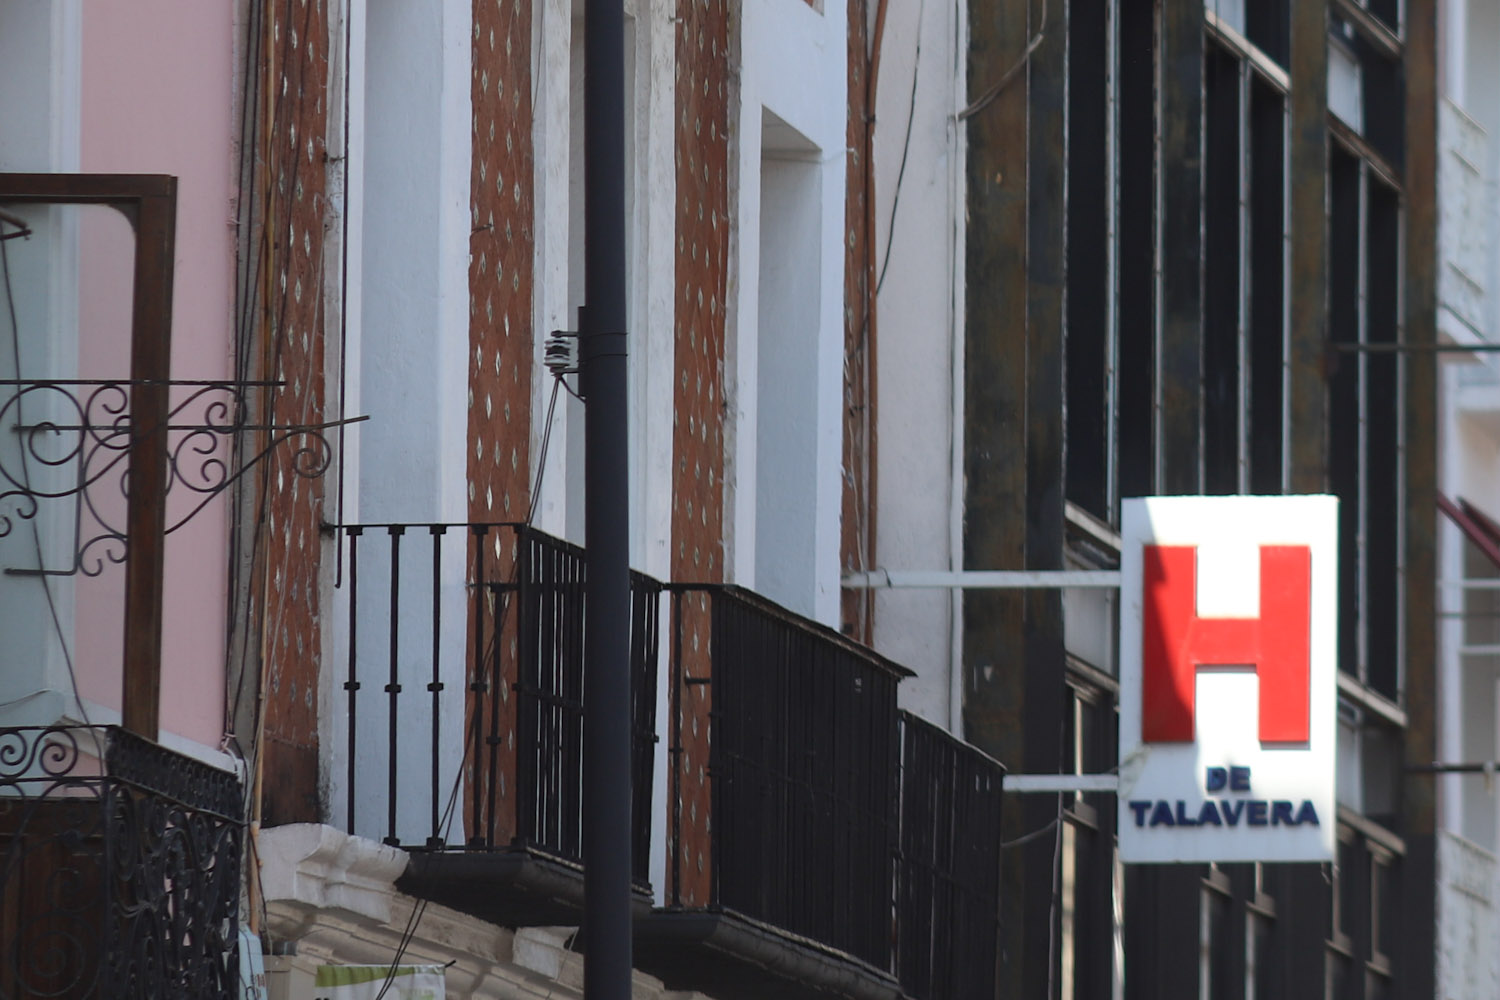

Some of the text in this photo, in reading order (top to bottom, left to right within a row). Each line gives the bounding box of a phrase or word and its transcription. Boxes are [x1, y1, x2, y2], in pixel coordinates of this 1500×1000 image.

[1142, 544, 1311, 746] H
[1206, 766, 1251, 792] DE
[1128, 800, 1320, 828] TALAVERA
